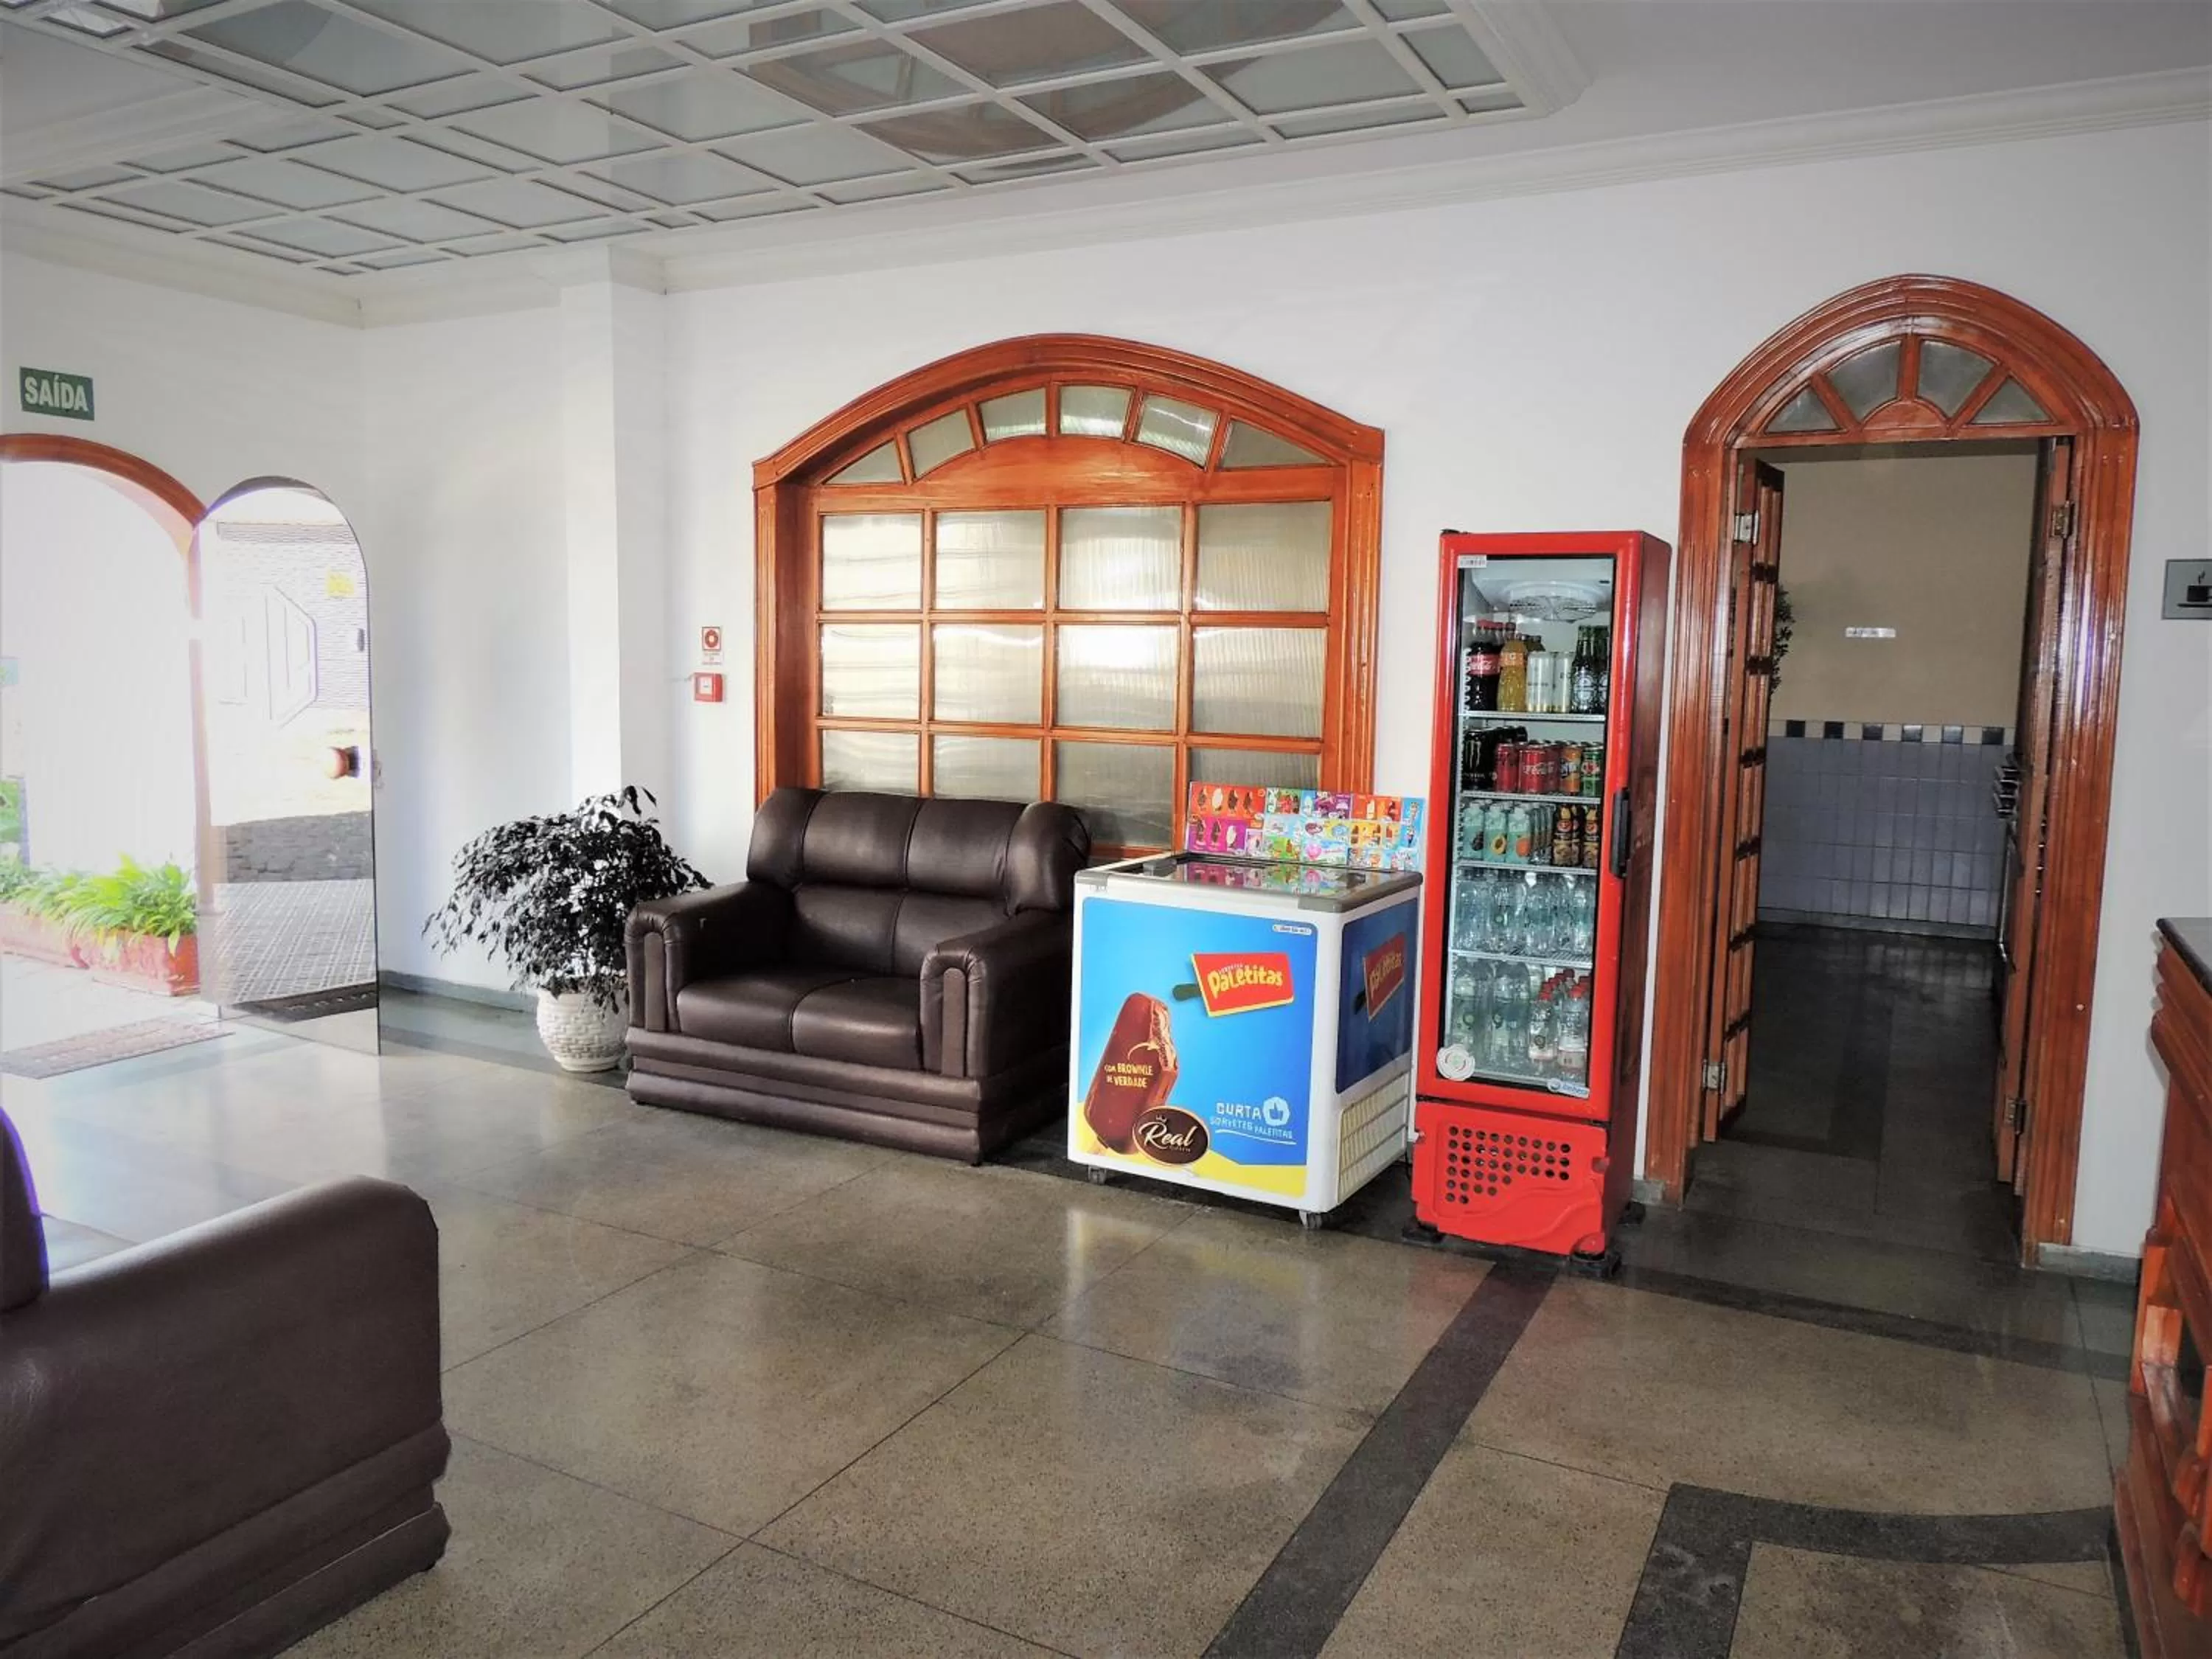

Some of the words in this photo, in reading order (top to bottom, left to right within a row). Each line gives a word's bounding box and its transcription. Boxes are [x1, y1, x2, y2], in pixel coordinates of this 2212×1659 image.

[24, 375, 89, 412] SAÍDA
[1113, 1076, 1147, 1088] VERDADE
[1138, 1121, 1197, 1149] Real
